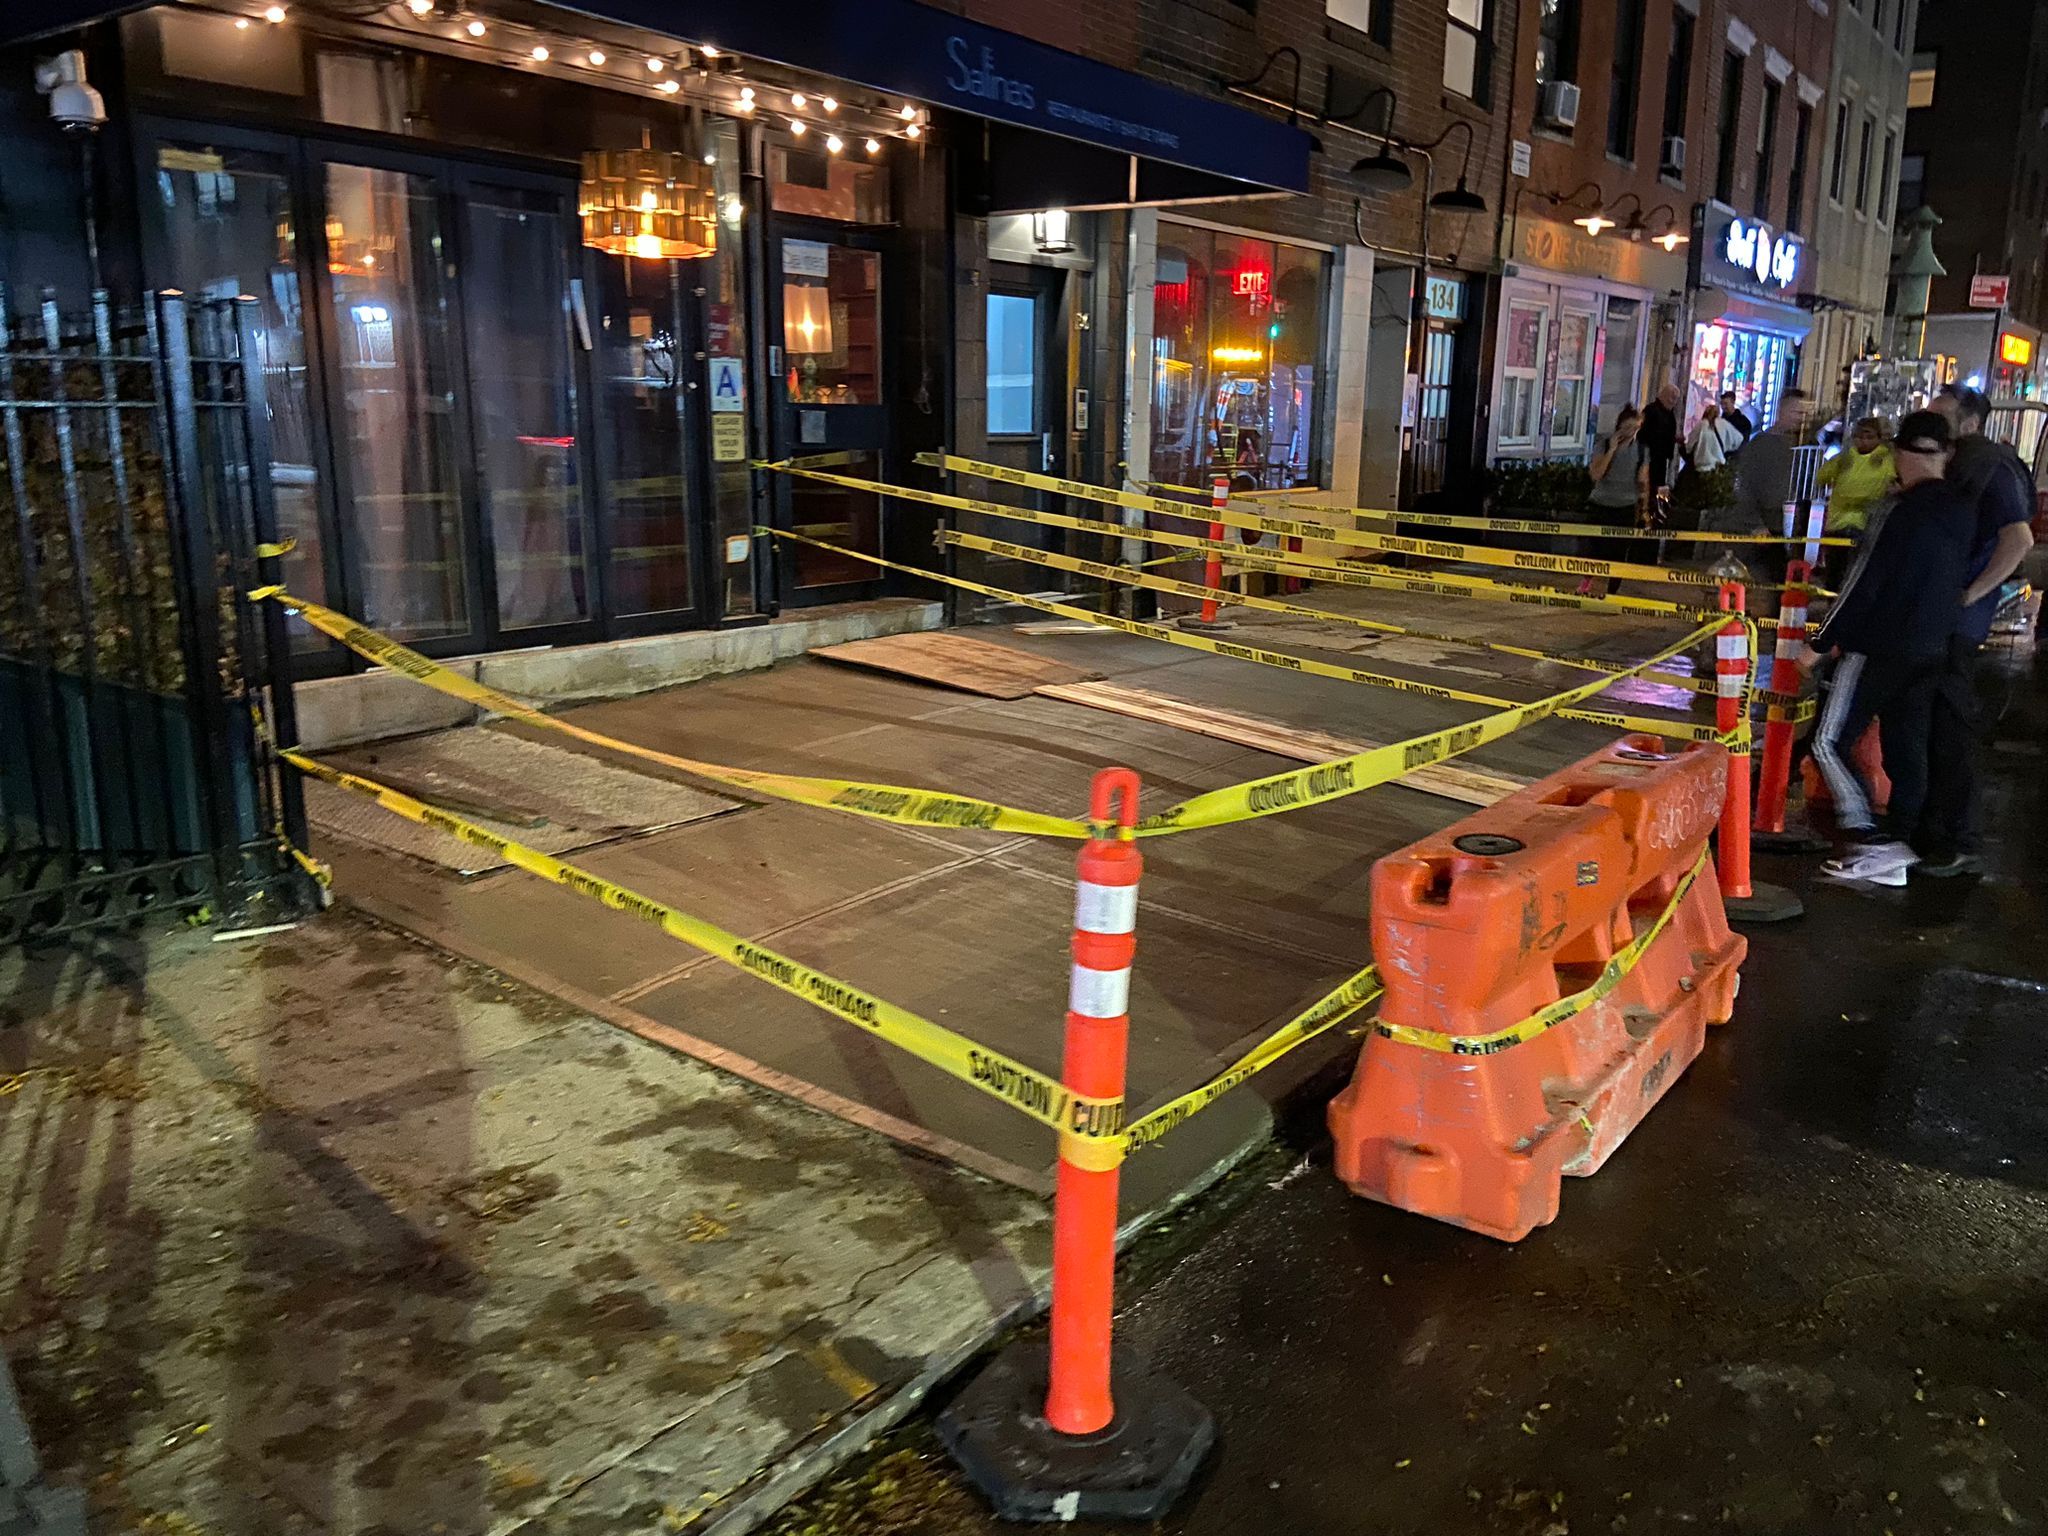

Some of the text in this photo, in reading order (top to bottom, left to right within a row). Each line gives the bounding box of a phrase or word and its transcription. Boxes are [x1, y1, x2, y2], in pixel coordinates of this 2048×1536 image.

[944, 36, 1036, 110] Salinas
[1239, 272, 1264, 291] EXIT
[1431, 282, 1455, 312] 134
[716, 366, 737, 397] A
[1528, 523, 1560, 533] CAUTION
[1215, 642, 1253, 659] CUIDADO
[1262, 654, 1302, 671] CAUTION
[967, 1050, 1051, 1115] CAUTION
